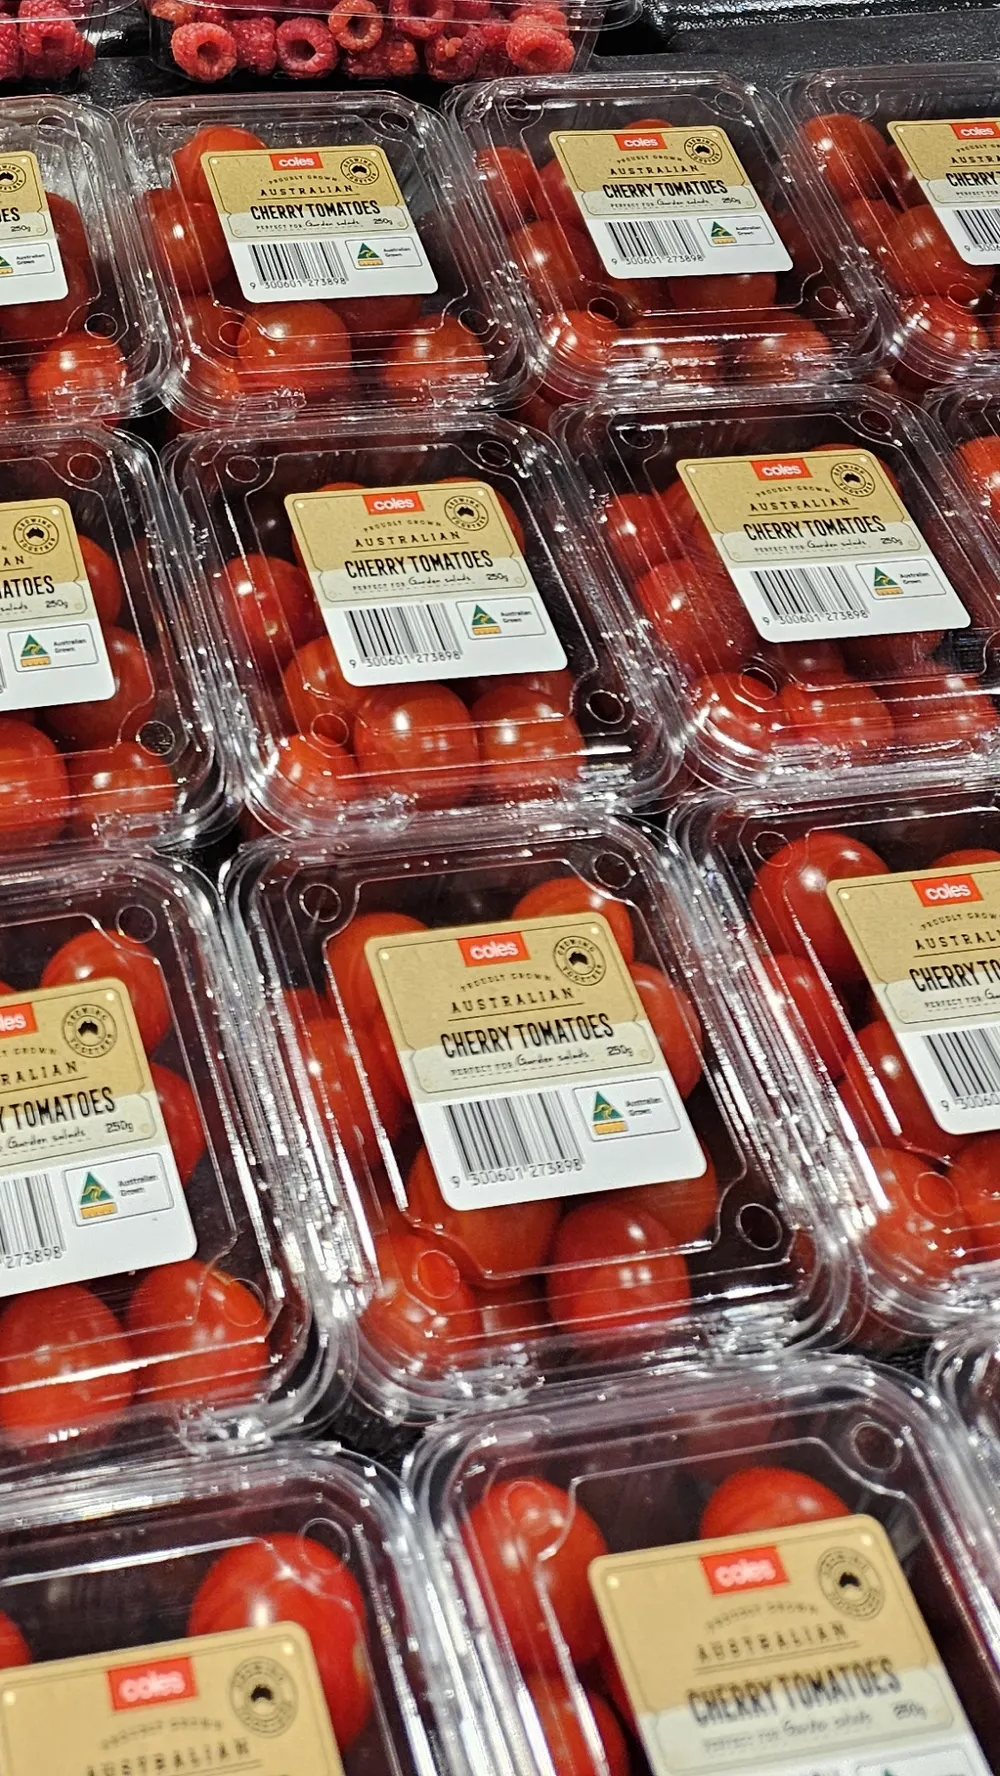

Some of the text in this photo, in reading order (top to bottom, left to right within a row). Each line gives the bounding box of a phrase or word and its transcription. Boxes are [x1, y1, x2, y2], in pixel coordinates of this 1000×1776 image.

[959, 125, 995, 137] coles
[622, 136, 659, 148] coles
[277, 155, 315, 168] coles
[609, 163, 699, 176] AUSTRALIAN
[944, 170, 998, 187] CHERRY
[259, 183, 353, 197] AUSTRALIAN
[601, 178, 728, 199] CHERRY TOMATOES
[249, 199, 381, 221] CHERRY TOMATOES
[609, 257, 618, 266] 9
[248, 281, 256, 290] 9
[760, 462, 802, 477] coles
[372, 496, 415, 511] coles
[748, 496, 851, 512] AUSTRALIAN
[741, 514, 886, 541] CHERRY TOMATOES
[354, 530, 460, 547] AUSTRALIAN
[343, 549, 494, 578] CHERRY TOMATOES
[761, 615, 770, 626] 9
[347, 657, 356, 669] 9
[924, 882, 971, 901] coles
[469, 940, 519, 960] coles
[908, 960, 979, 992] CHERRY
[450, 985, 573, 1014] AUSTRALIAN
[439, 1011, 613, 1058] CHERRY TOMATOES
[7, 1084, 115, 1129] TOMATOES
[954, 1090, 1000, 1111] 30060
[688, 1655, 899, 1724] CHERRY TOMATOES
